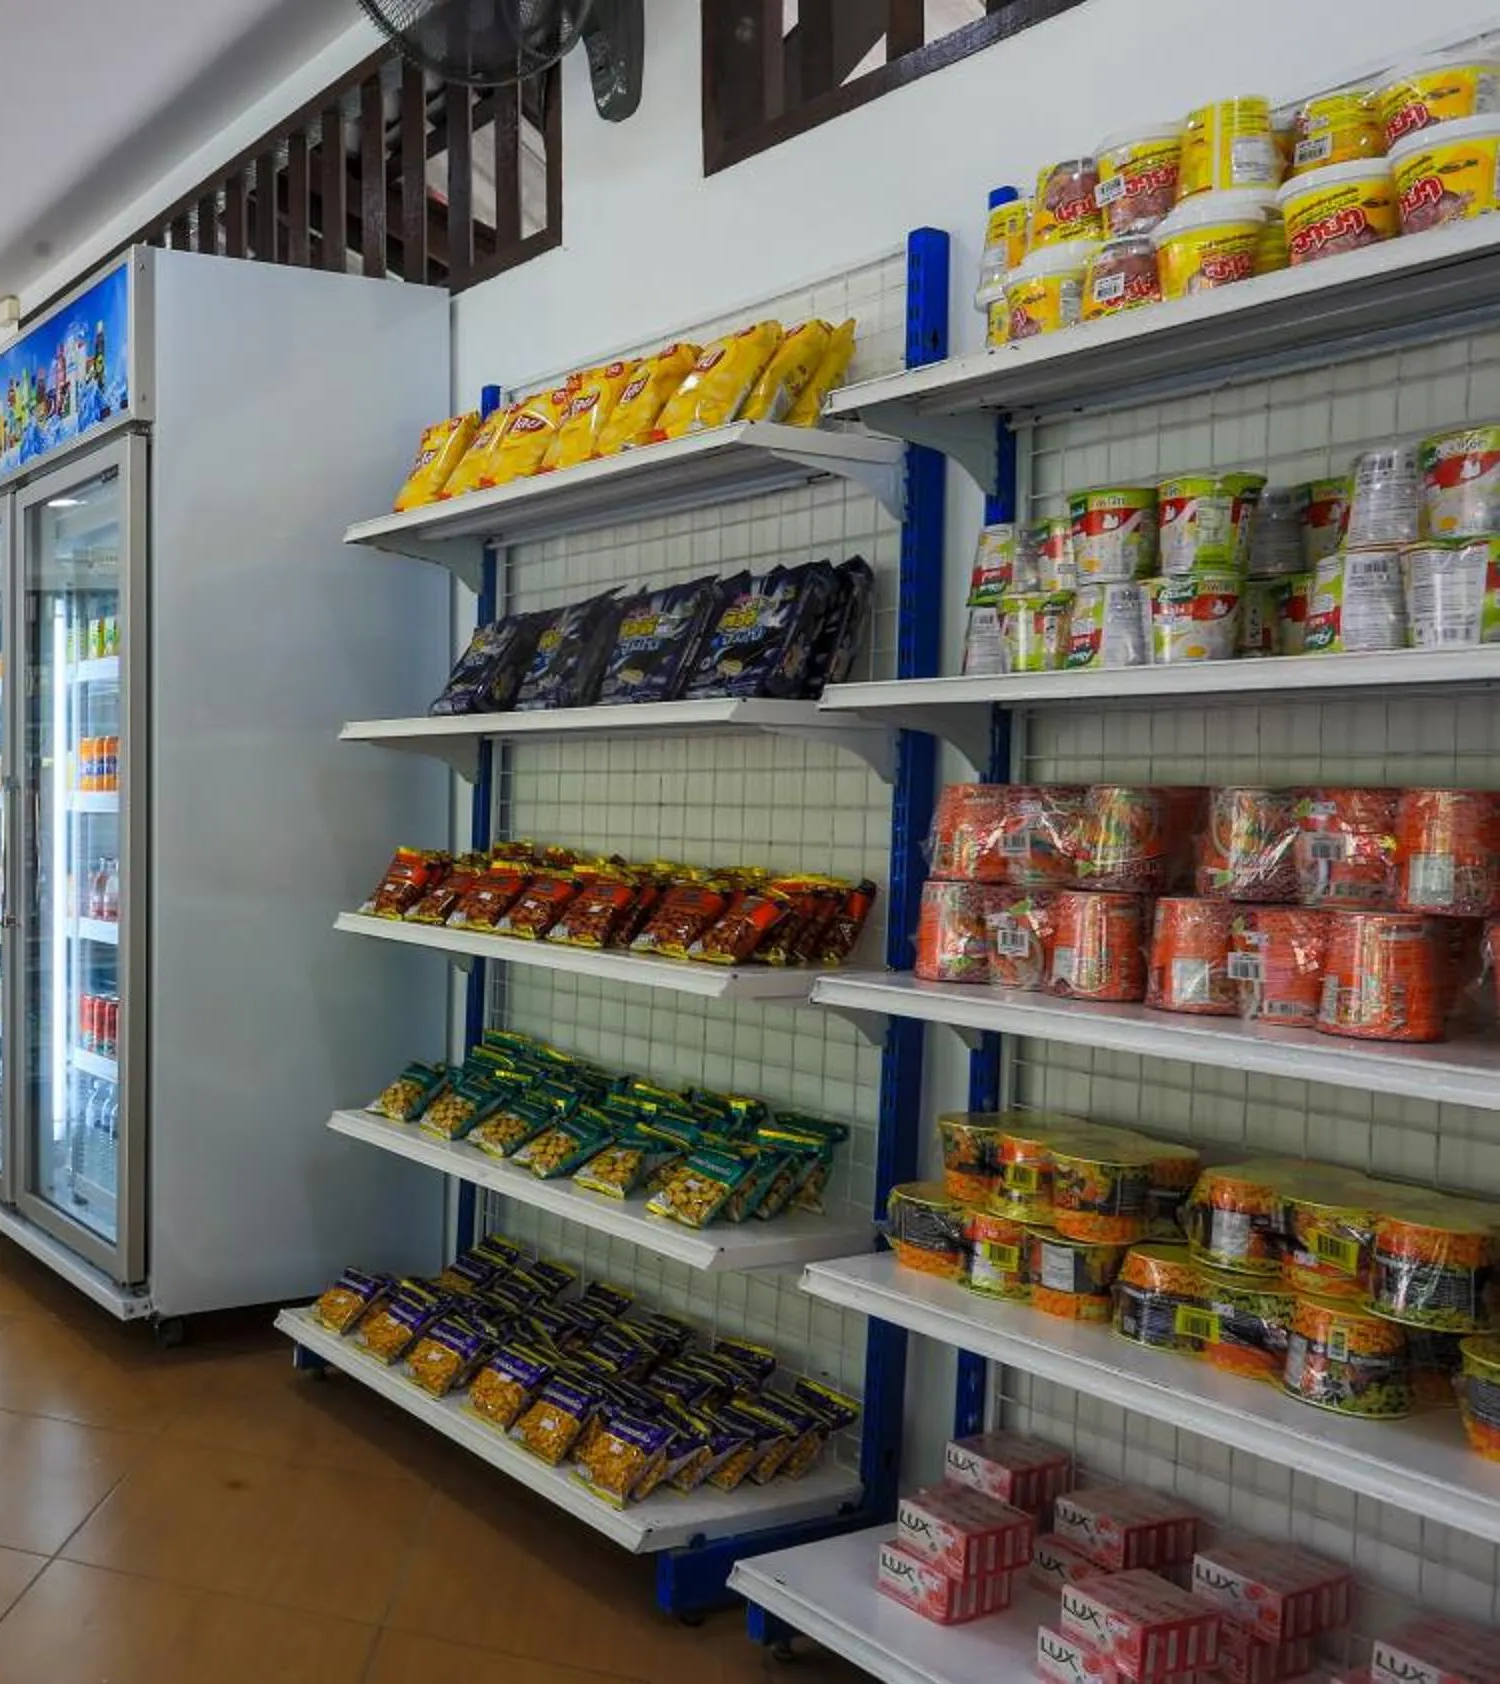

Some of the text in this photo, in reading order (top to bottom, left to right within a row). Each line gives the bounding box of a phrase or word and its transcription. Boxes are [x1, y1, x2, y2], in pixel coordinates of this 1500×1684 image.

[947, 1449, 979, 1477] LUX
[900, 1509, 933, 1538] LUX
[1056, 1506, 1092, 1533] LUX
[881, 1552, 915, 1582] LUX
[1034, 1551, 1067, 1578] UX
[1195, 1563, 1239, 1599] LUX
[1063, 1592, 1102, 1630] LUX
[1040, 1636, 1079, 1672] LUX
[1376, 1651, 1432, 1684] LUX
